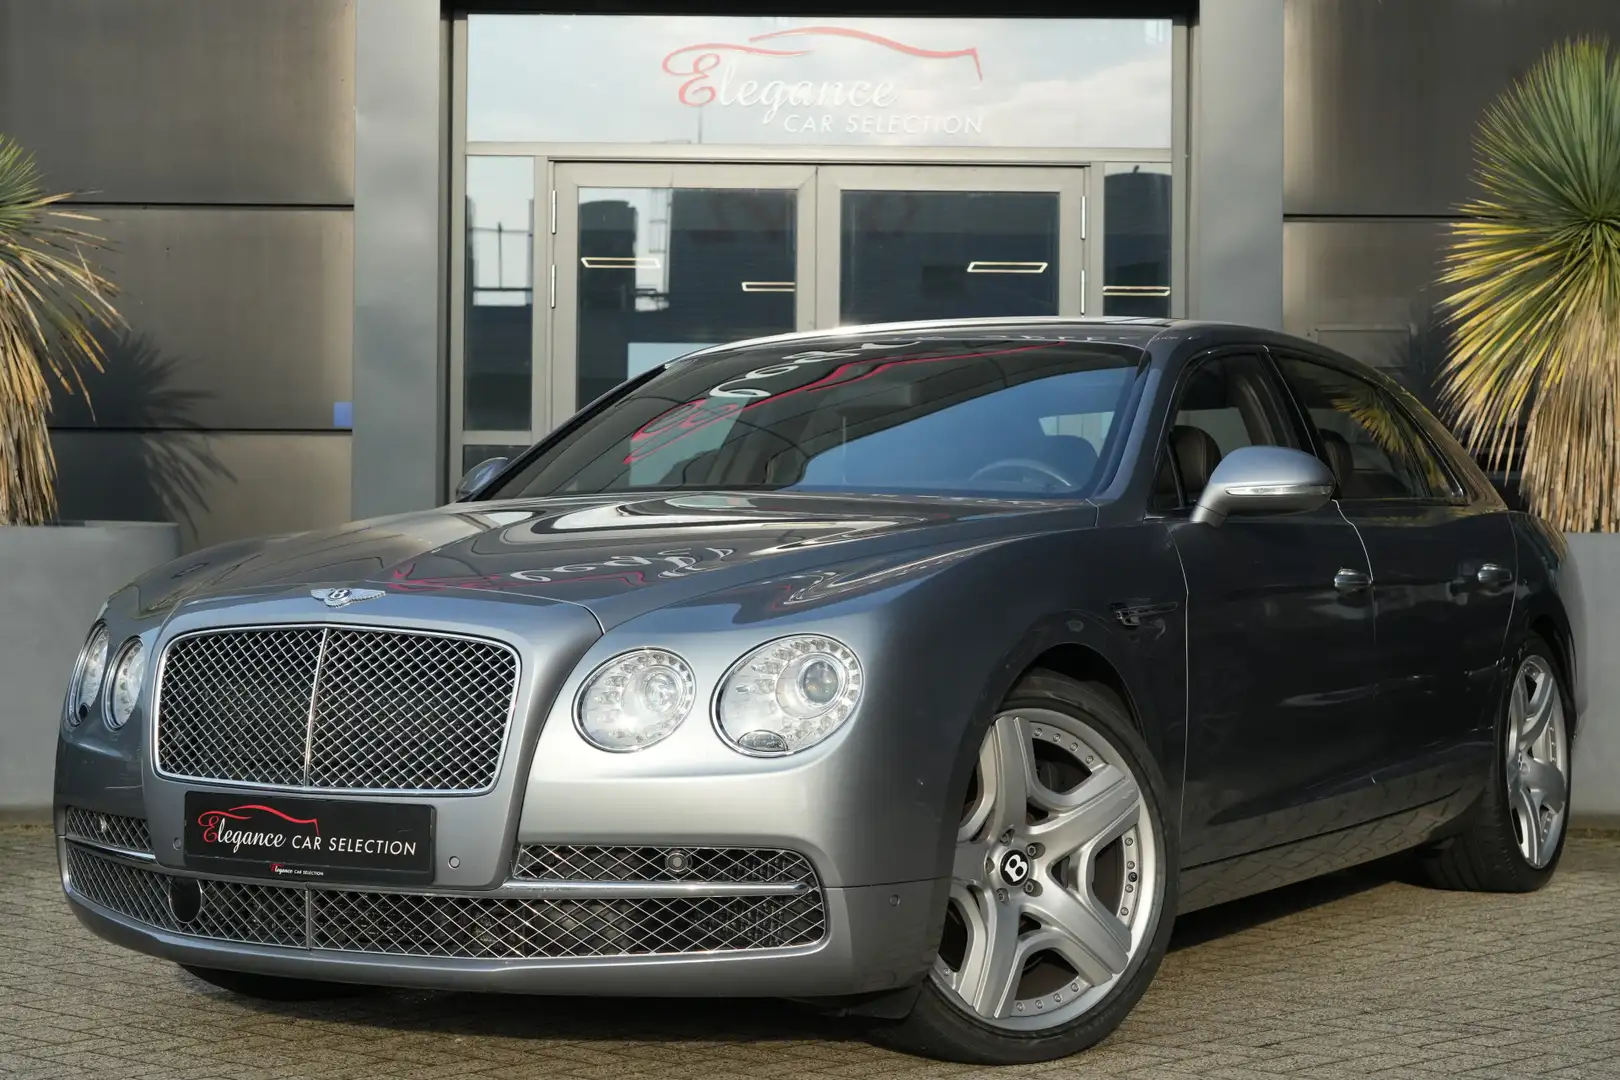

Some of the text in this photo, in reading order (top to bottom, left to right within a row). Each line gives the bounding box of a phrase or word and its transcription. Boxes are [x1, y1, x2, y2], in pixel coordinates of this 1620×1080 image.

[662, 43, 897, 125] Elegance
[784, 114, 983, 134] CAR SELECTION
[198, 811, 417, 856] Elegance CAR SELECTION
[1004, 854, 1028, 882] B
